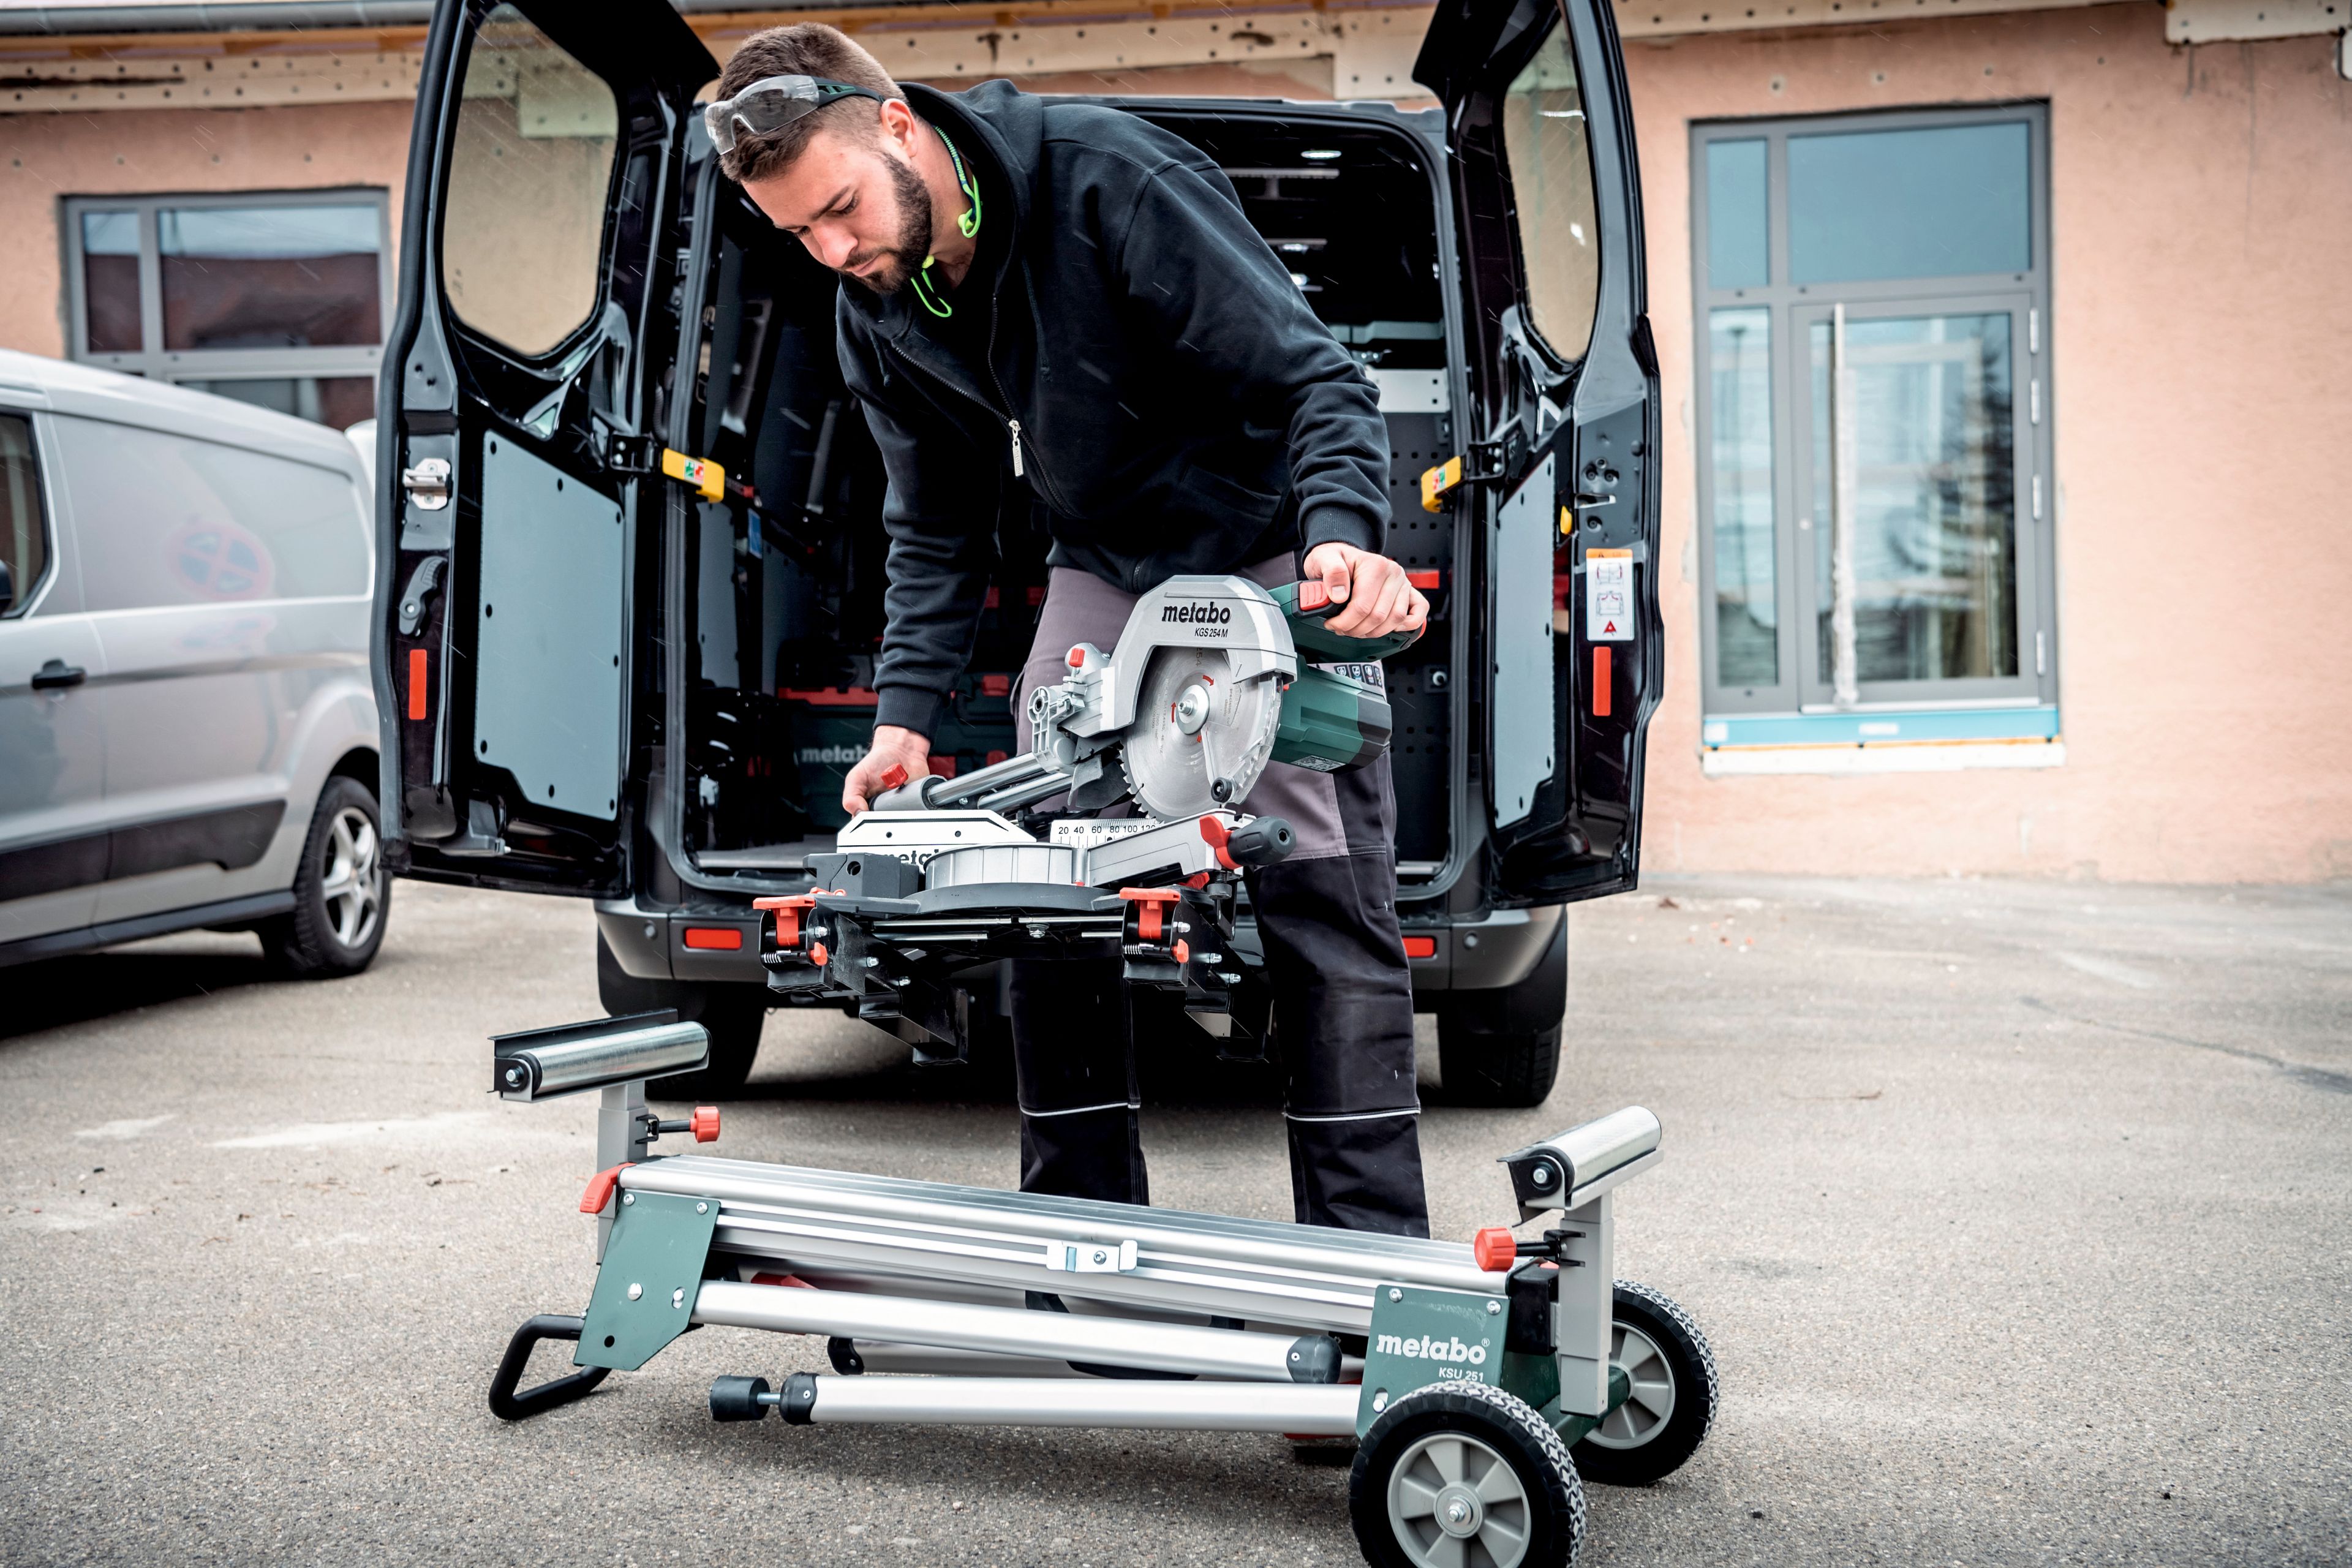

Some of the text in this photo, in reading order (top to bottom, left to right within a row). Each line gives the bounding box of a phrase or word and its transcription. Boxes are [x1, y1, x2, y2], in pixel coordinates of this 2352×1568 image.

[1161, 601, 1231, 624] metabo
[1194, 628, 1209, 637] KGS
[1439, 1367, 1483, 1382] KSU 251
